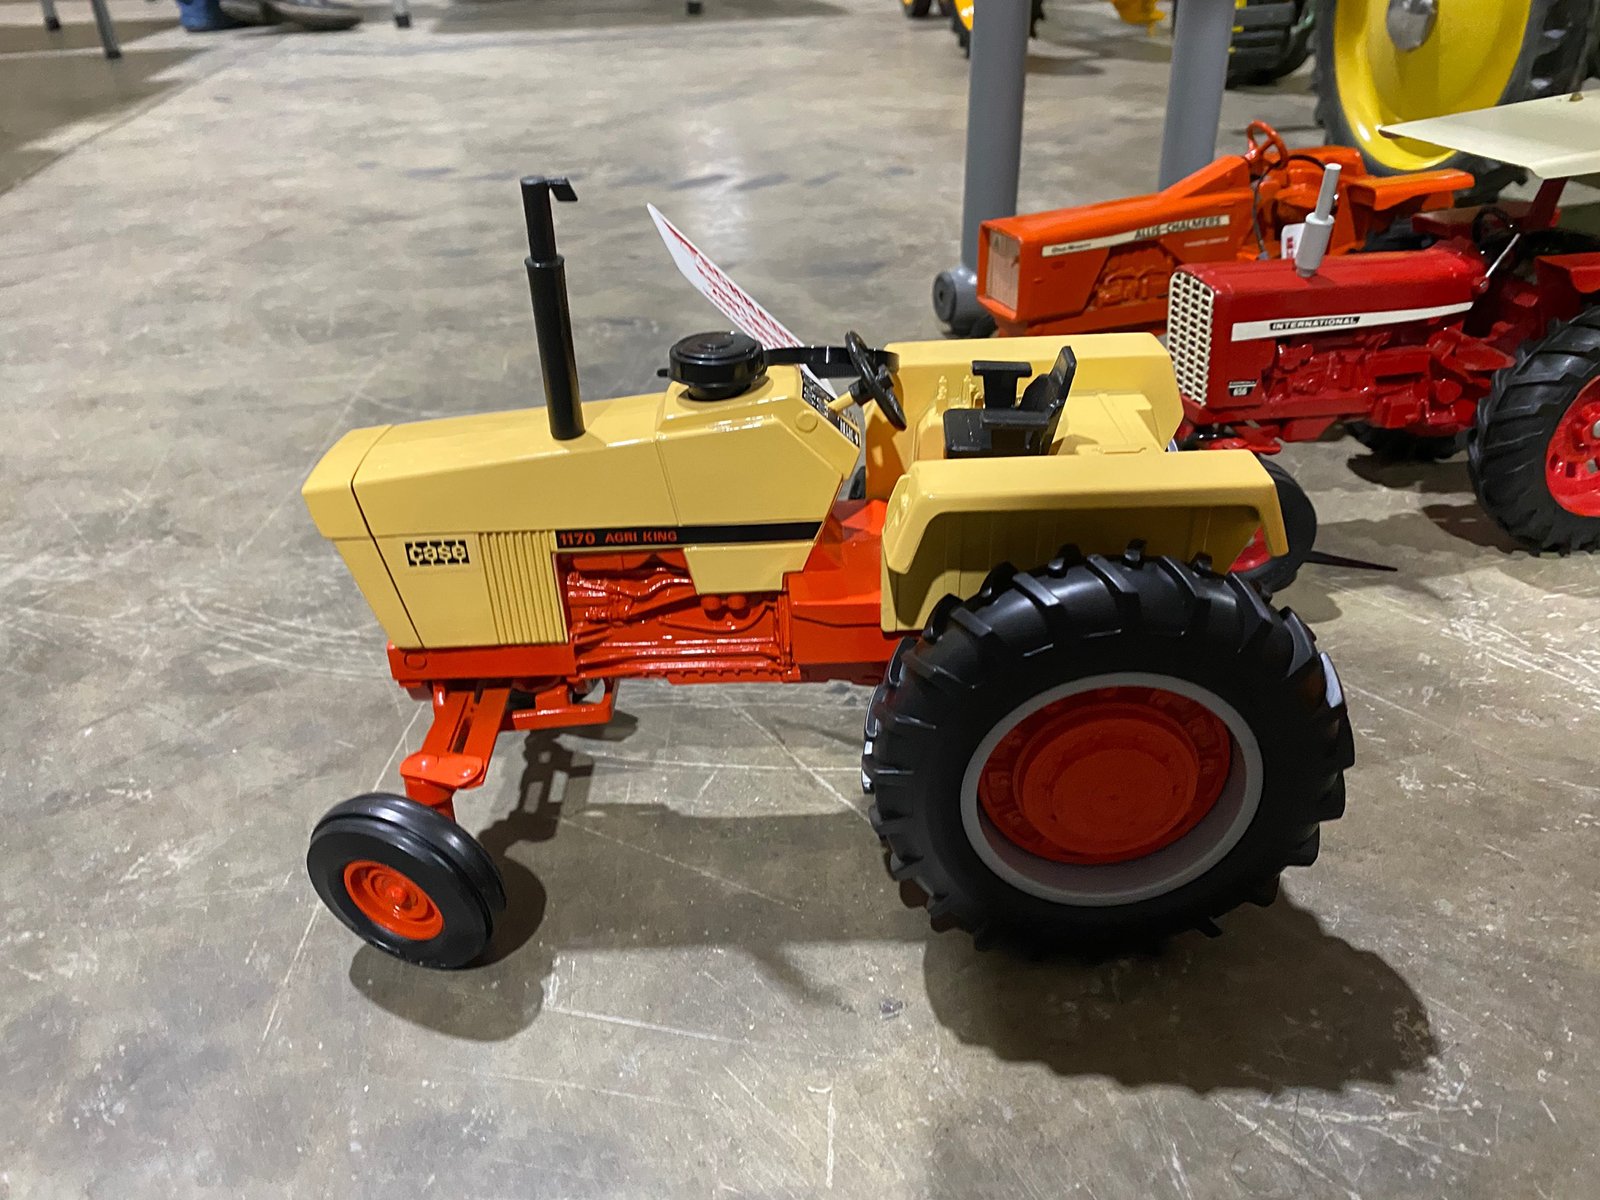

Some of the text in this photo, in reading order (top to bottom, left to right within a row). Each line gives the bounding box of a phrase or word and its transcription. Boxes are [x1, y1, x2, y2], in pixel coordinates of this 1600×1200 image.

[1134, 216, 1221, 240] ALLIS-CHALMERS
[1271, 317, 1358, 330] INTERNATIONAL
[559, 531, 678, 546] 1170 AGRI KING
